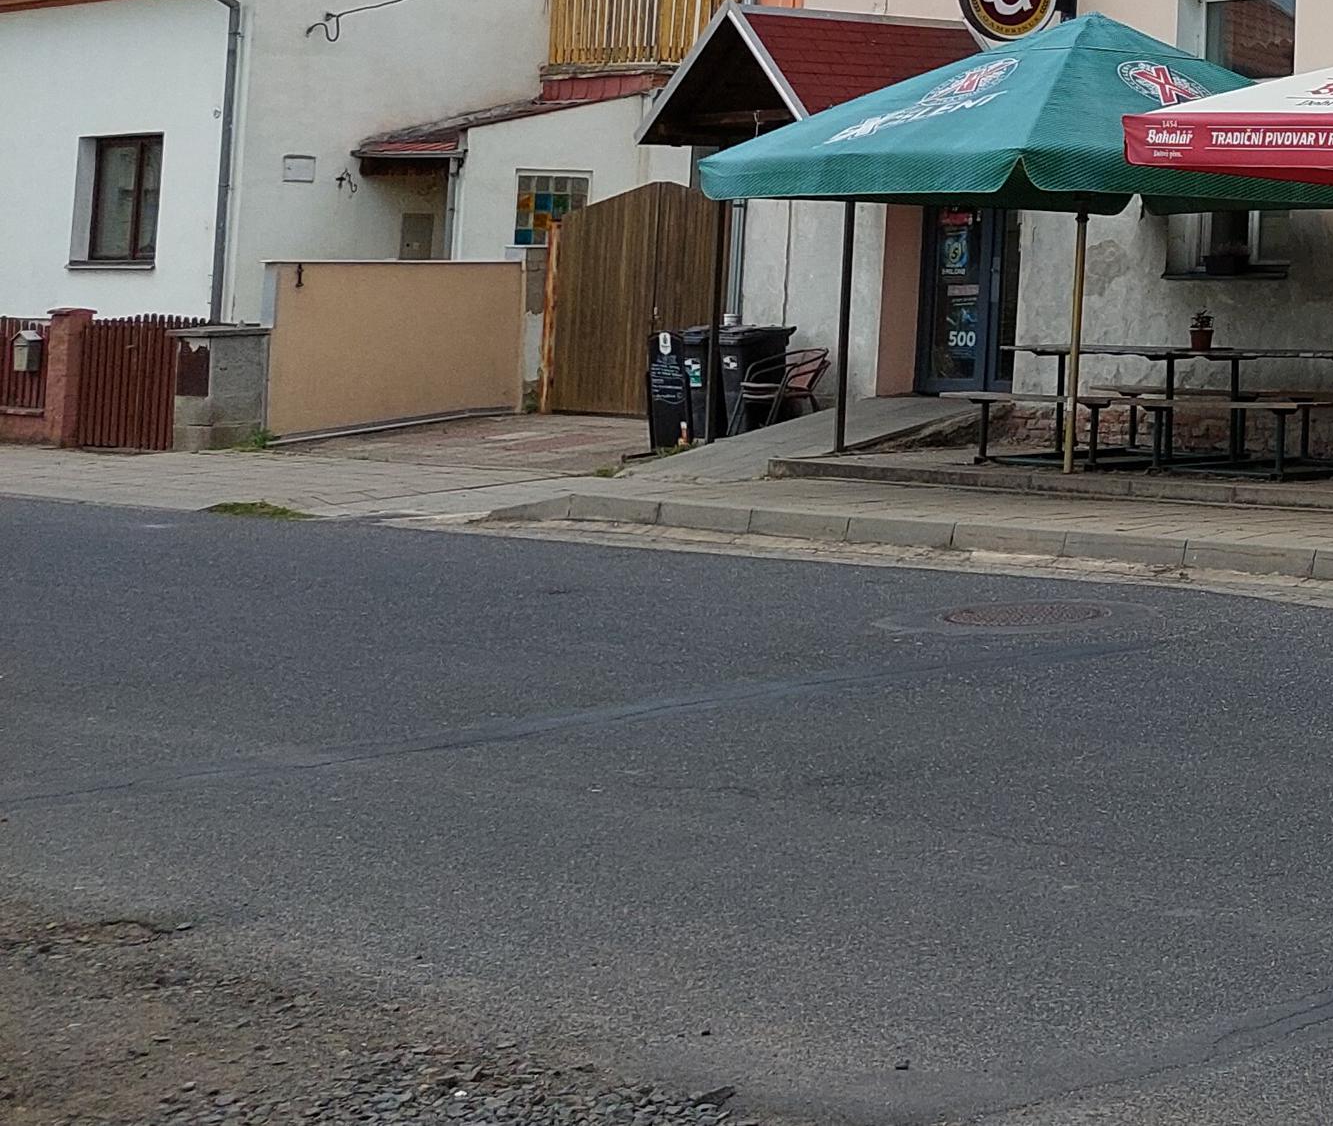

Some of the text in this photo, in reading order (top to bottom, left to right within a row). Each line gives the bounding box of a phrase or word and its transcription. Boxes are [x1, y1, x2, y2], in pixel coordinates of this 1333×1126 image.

[1146, 129, 1193, 144] Bakalář
[1211, 128, 1263, 146] TRADIČNÍ
[1265, 132, 1316, 146] PIVOVAR
[1317, 132, 1327, 146] V
[948, 331, 976, 347] 500
